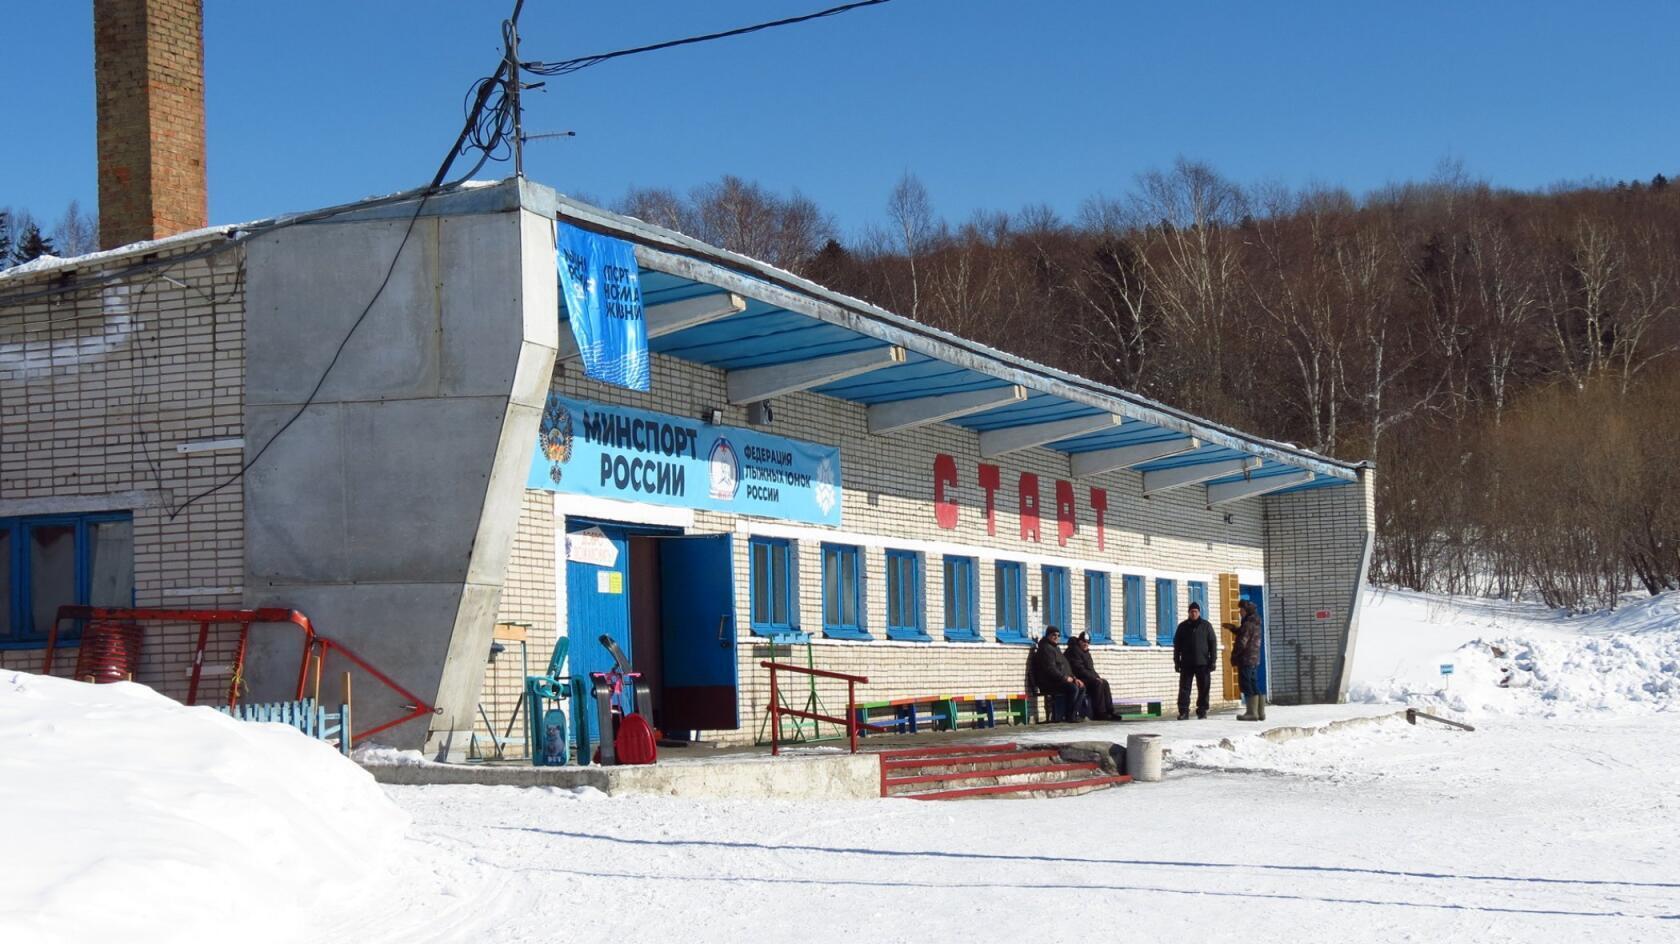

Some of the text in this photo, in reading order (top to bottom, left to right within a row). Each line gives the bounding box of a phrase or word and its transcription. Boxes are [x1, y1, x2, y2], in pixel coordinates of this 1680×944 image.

[583, 409, 698, 460] МИНСПОРТ
[744, 444, 792, 467] ФЕДЕРАЦИЯ
[600, 452, 685, 497] РОССИИ
[745, 464, 784, 484] ЛЫЖНЫХ
[746, 484, 779, 502] РОССИИ
[934, 453, 1108, 552] СТАРТ
